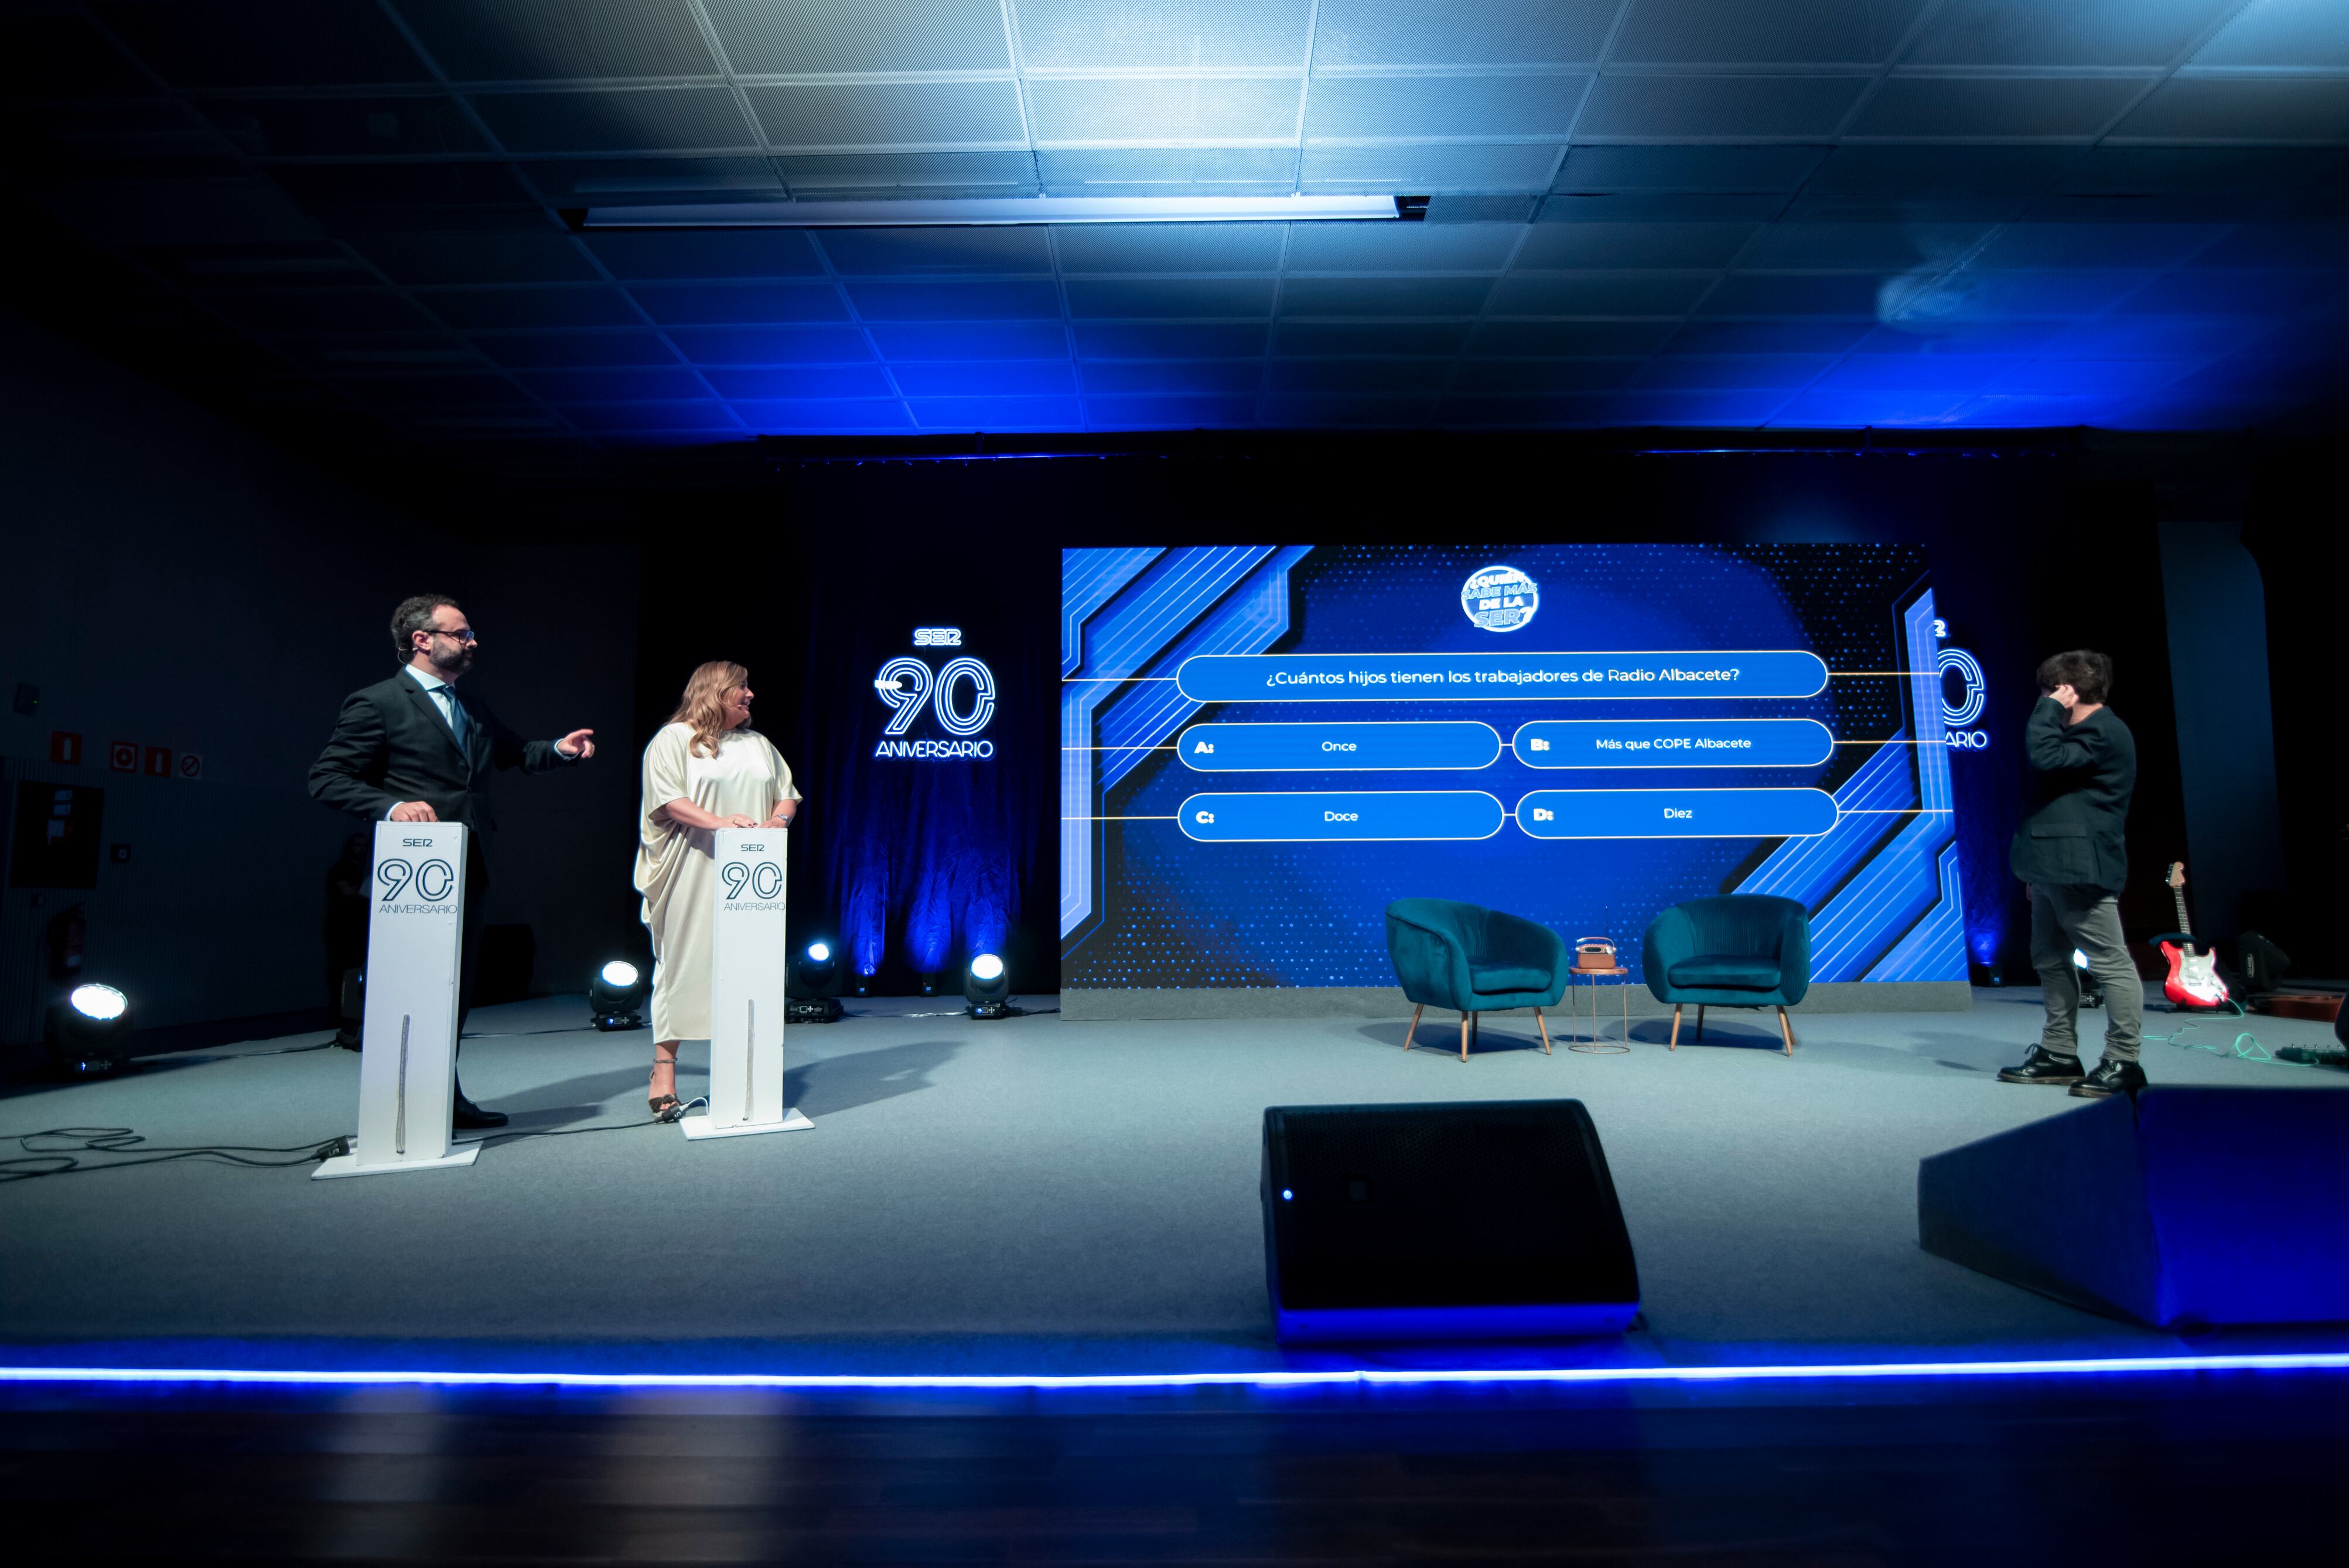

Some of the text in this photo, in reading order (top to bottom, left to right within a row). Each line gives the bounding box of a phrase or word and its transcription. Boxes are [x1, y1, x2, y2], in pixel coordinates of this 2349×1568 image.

[1461, 582, 1538, 600] SABE MÁS
[1479, 596, 1524, 610] DE LA
[1474, 607, 1534, 628] SER?
[914, 628, 961, 645] SER
[1266, 668, 1740, 686] ¿Cuántos hijos tienen los trabajadores de Radio Albacete?
[878, 657, 995, 736] 90
[875, 740, 993, 758] ANIVERSARIO
[1194, 741, 1357, 754] A: Once
[1530, 737, 1751, 751] B: Más que COPE Albacete
[1196, 811, 1358, 824] C: Doce
[1533, 808, 1692, 821] D: Diez
[402, 838, 433, 848] SER
[377, 858, 454, 902] 90
[722, 862, 783, 900] 90
[379, 904, 458, 914] ANIVERSARIO
[723, 902, 786, 911] ANIVERSARIO
